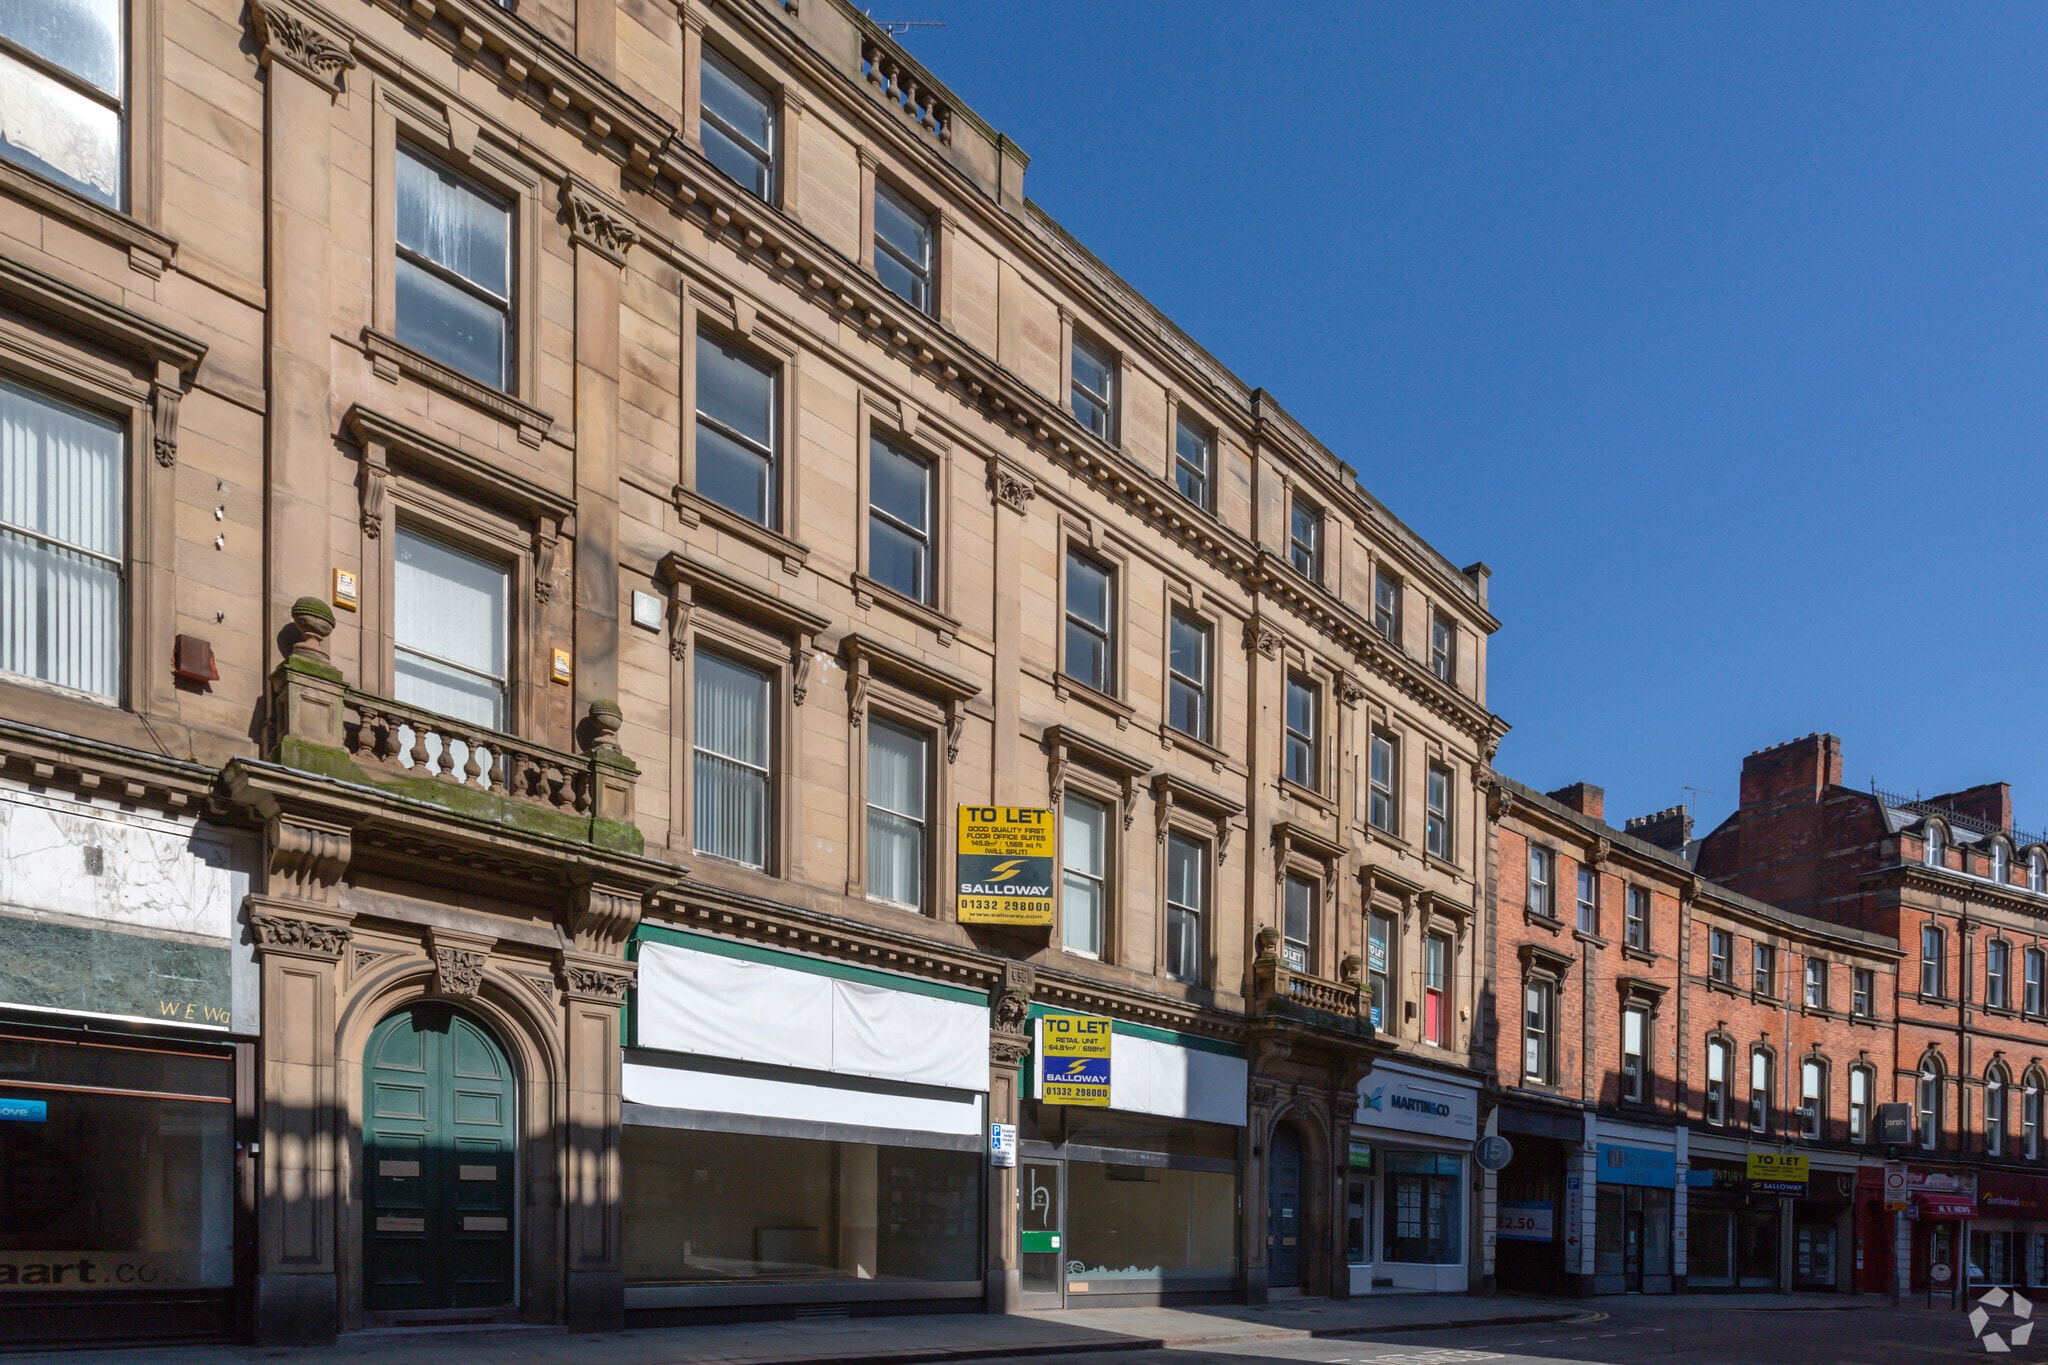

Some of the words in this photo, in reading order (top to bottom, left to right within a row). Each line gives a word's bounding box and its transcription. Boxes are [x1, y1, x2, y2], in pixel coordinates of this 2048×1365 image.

[966, 807, 997, 823] TO
[1006, 808, 1046, 824] LET
[991, 826, 1022, 834] QUALITY
[966, 832, 991, 840] FLOOR
[961, 883, 1050, 896] SALLOWAY
[961, 899, 998, 910] 01332
[1004, 901, 1050, 912] 298000
[969, 912, 1043, 920] www.salloway.com
[1289, 950, 1301, 963] LET
[1375, 947, 1385, 959] LET
[204, 1006, 231, 1024] Wa
[1046, 1019, 1070, 1032] TO
[1077, 1020, 1109, 1034] LET
[1055, 1036, 1080, 1044] RETAIL
[1046, 1073, 1107, 1083] SALLOWAY
[1046, 1086, 1072, 1096] 01332
[1075, 1088, 1108, 1097] 298000
[1391, 1094, 1450, 1117] MARTIN&CO
[0, 1107, 28, 1116] ove
[1884, 1118, 1906, 1128] jarah
[993, 1125, 1000, 1136] P
[1484, 1142, 1501, 1161] 15
[1757, 1155, 1774, 1165] TO
[1780, 1156, 1800, 1166] LET
[1711, 1168, 1744, 1183] ENTURY
[1569, 1178, 1578, 1189] P
[1763, 1182, 1803, 1191] SALLOWAY
[1954, 1205, 1972, 1214] NEWS
[1497, 1217, 1535, 1230] £2.50
